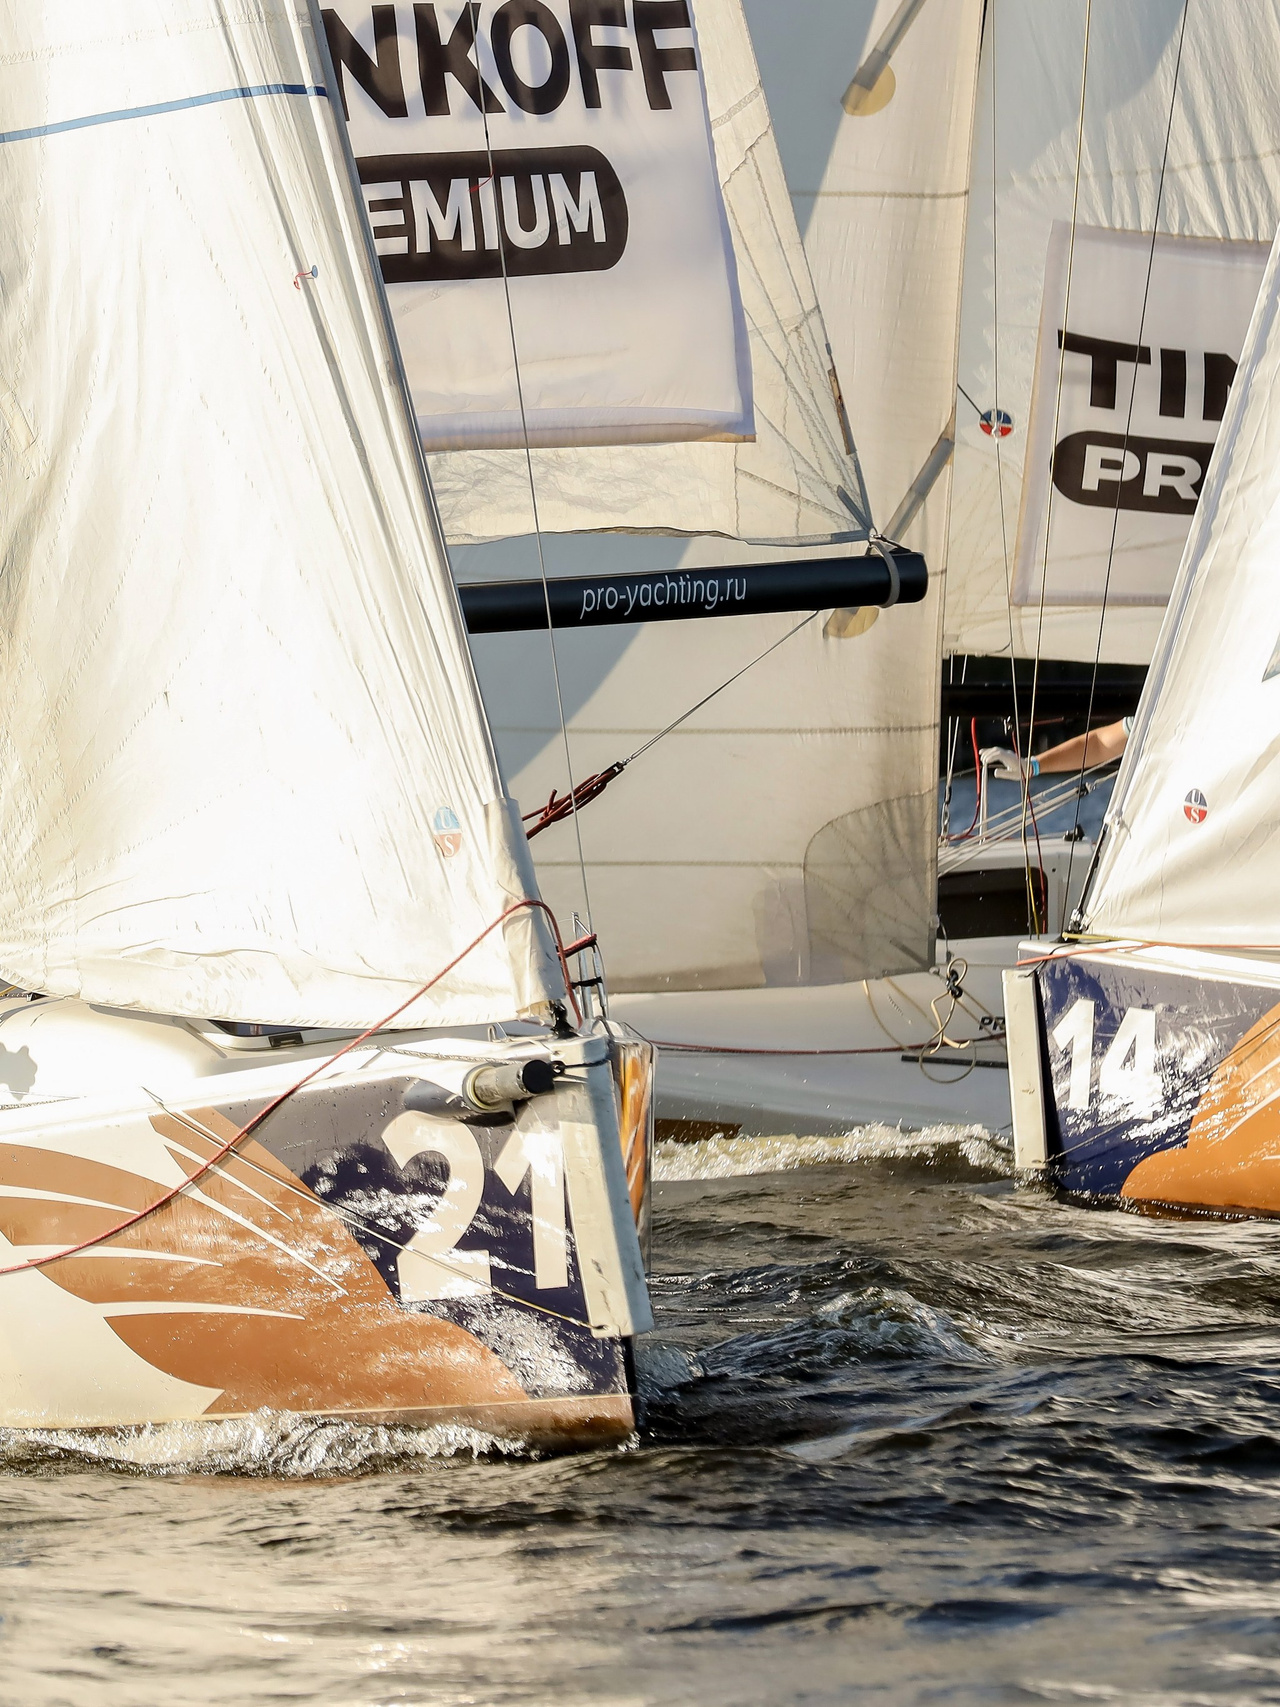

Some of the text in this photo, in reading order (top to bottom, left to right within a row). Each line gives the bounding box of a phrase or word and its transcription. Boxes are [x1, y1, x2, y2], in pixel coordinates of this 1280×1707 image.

[579, 574, 747, 620] pro-yachting.ru
[1052, 999, 1164, 1120] 14
[381, 1109, 569, 1302] 21
